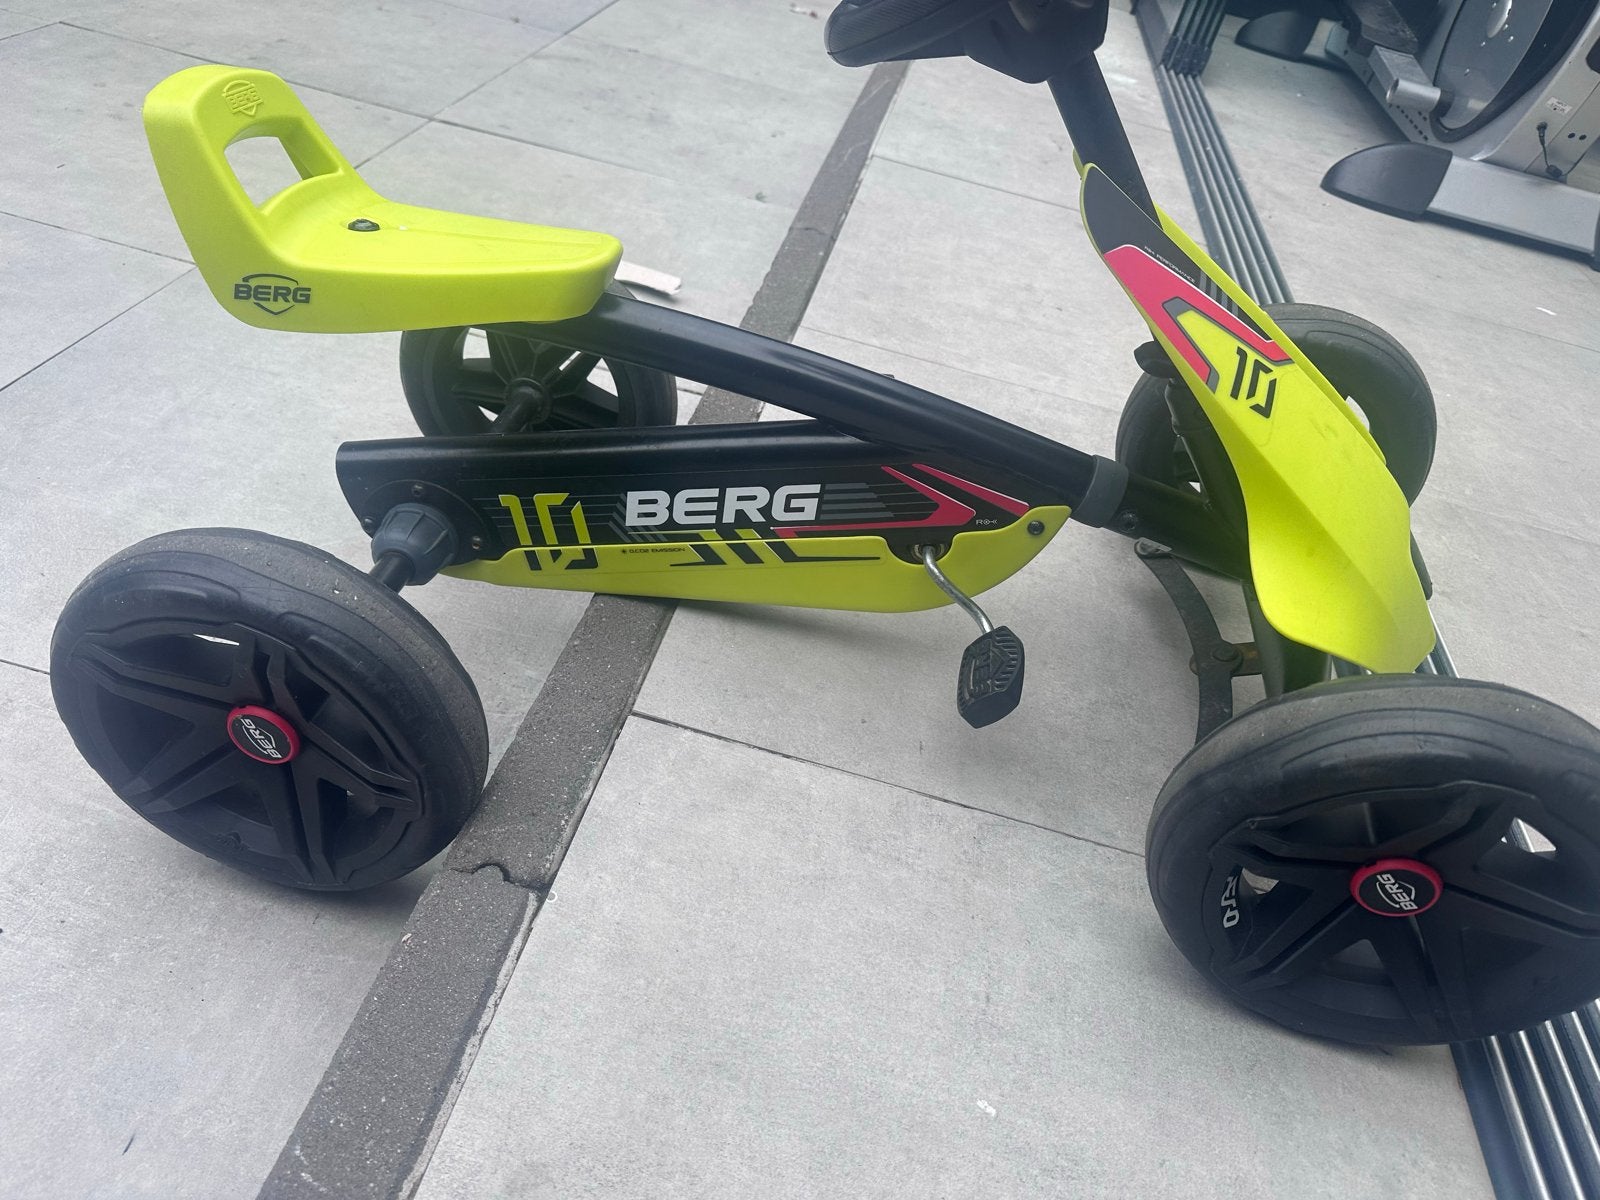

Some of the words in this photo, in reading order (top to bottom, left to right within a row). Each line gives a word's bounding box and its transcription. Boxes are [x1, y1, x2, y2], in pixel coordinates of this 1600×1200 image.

[234, 283, 312, 304] BERG
[1230, 346, 1277, 419] 10
[625, 484, 821, 527] BERG
[240, 718, 283, 758] BERG
[1376, 873, 1418, 910] BERG
